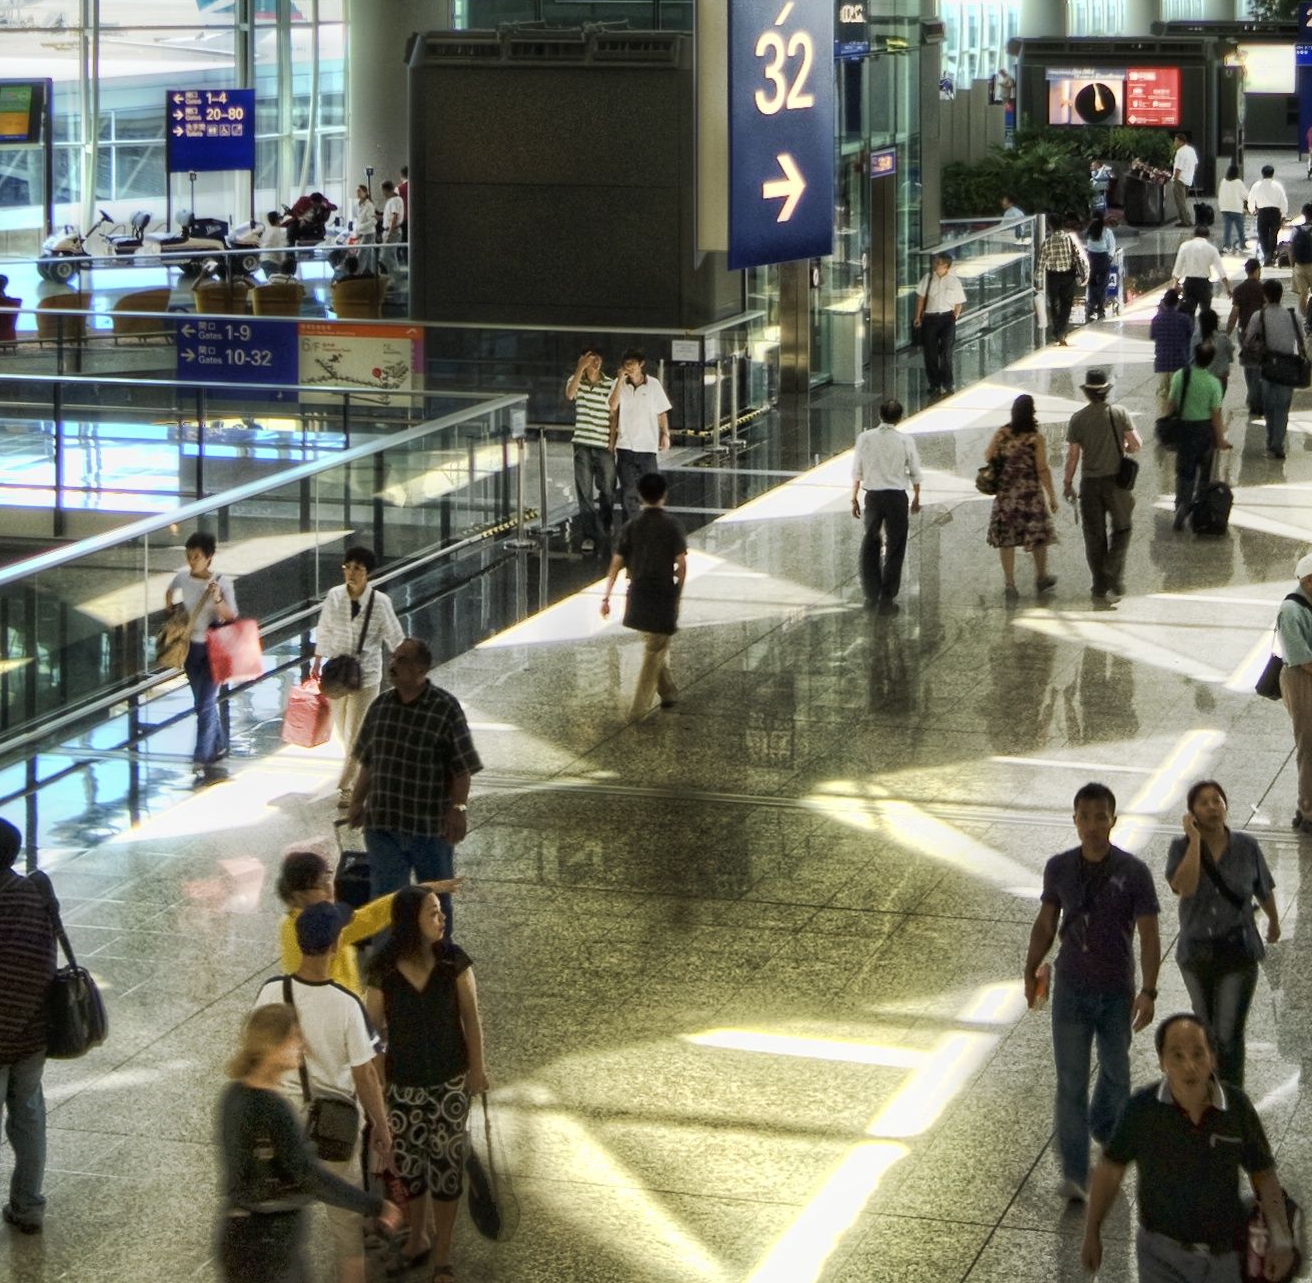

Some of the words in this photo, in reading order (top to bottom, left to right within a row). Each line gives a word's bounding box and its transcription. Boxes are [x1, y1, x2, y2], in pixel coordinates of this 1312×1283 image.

[754, 31, 814, 115] 32
[206, 92, 227, 105] 1-4
[206, 107, 244, 121] 20-80
[198, 331, 222, 340] Gates
[226, 324, 251, 341] 1-9
[198, 355, 222, 365] Gates
[225, 349, 272, 366] 10-32
